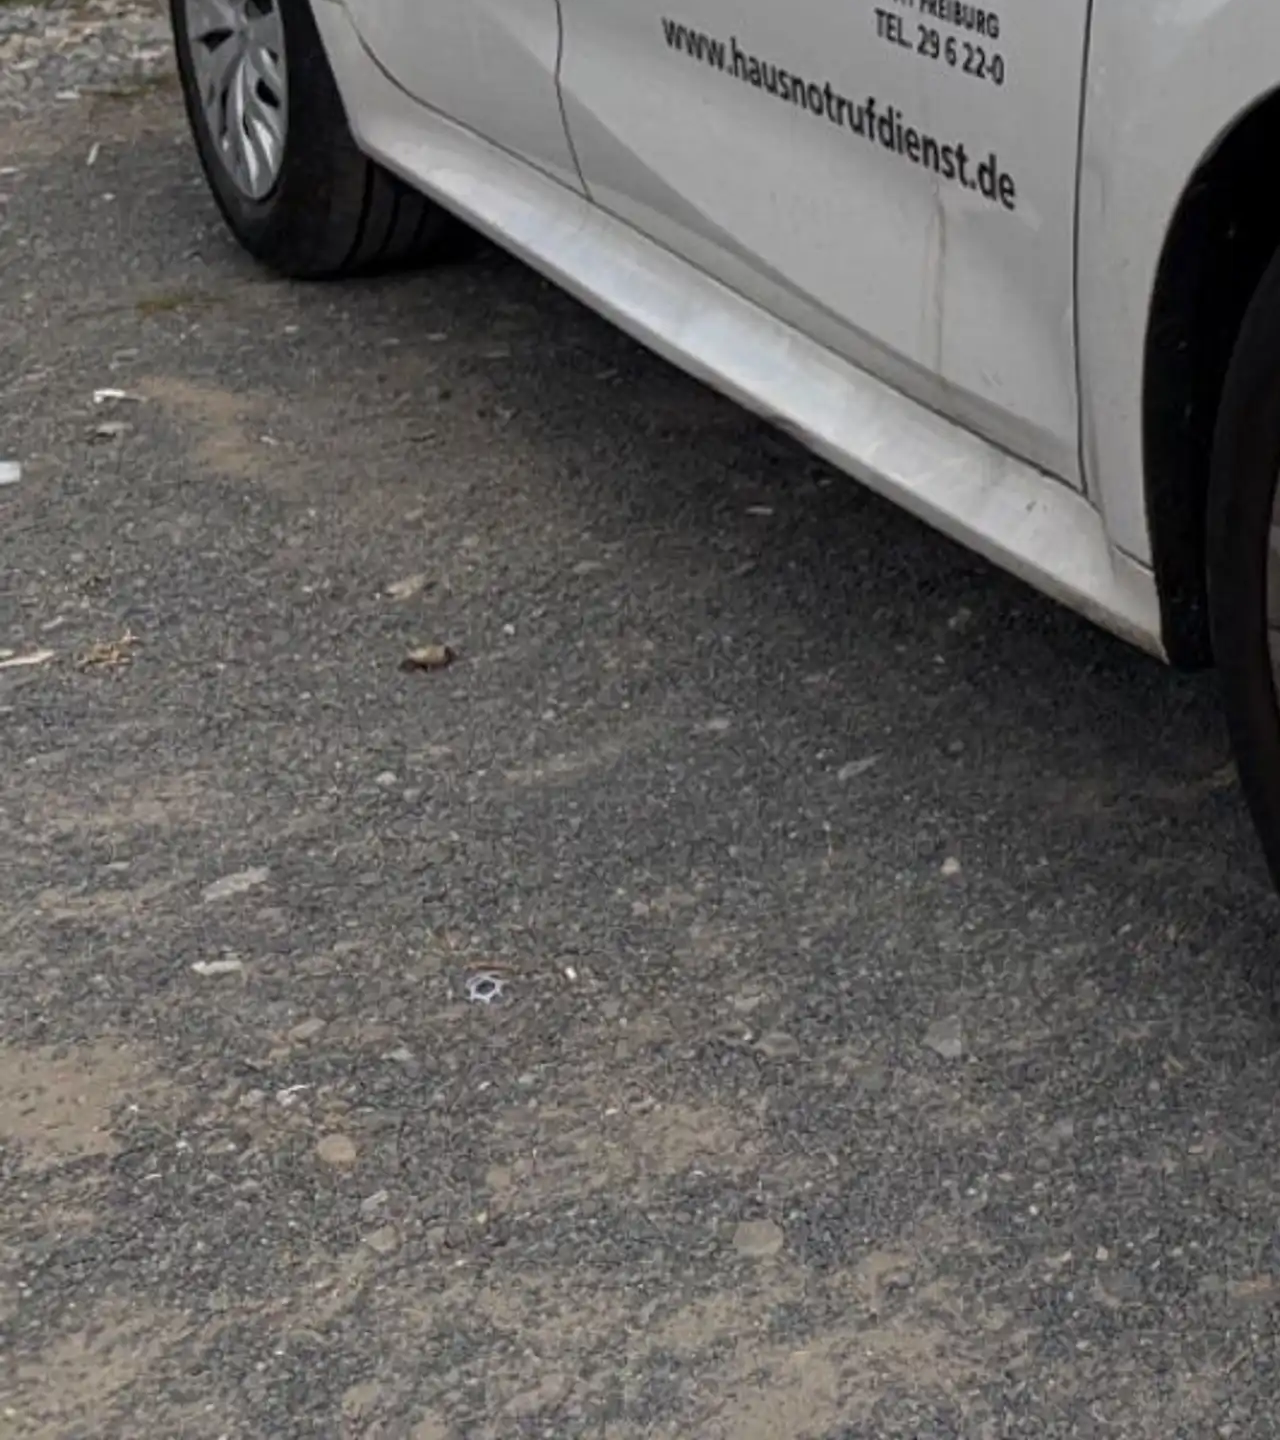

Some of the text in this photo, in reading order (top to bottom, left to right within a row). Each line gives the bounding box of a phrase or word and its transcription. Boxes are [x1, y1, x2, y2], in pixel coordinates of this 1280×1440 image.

[661, 15, 1016, 212] www.hausnotrufdienst.de
[874, 7, 1004, 86] TEL. 29 6 22-0
